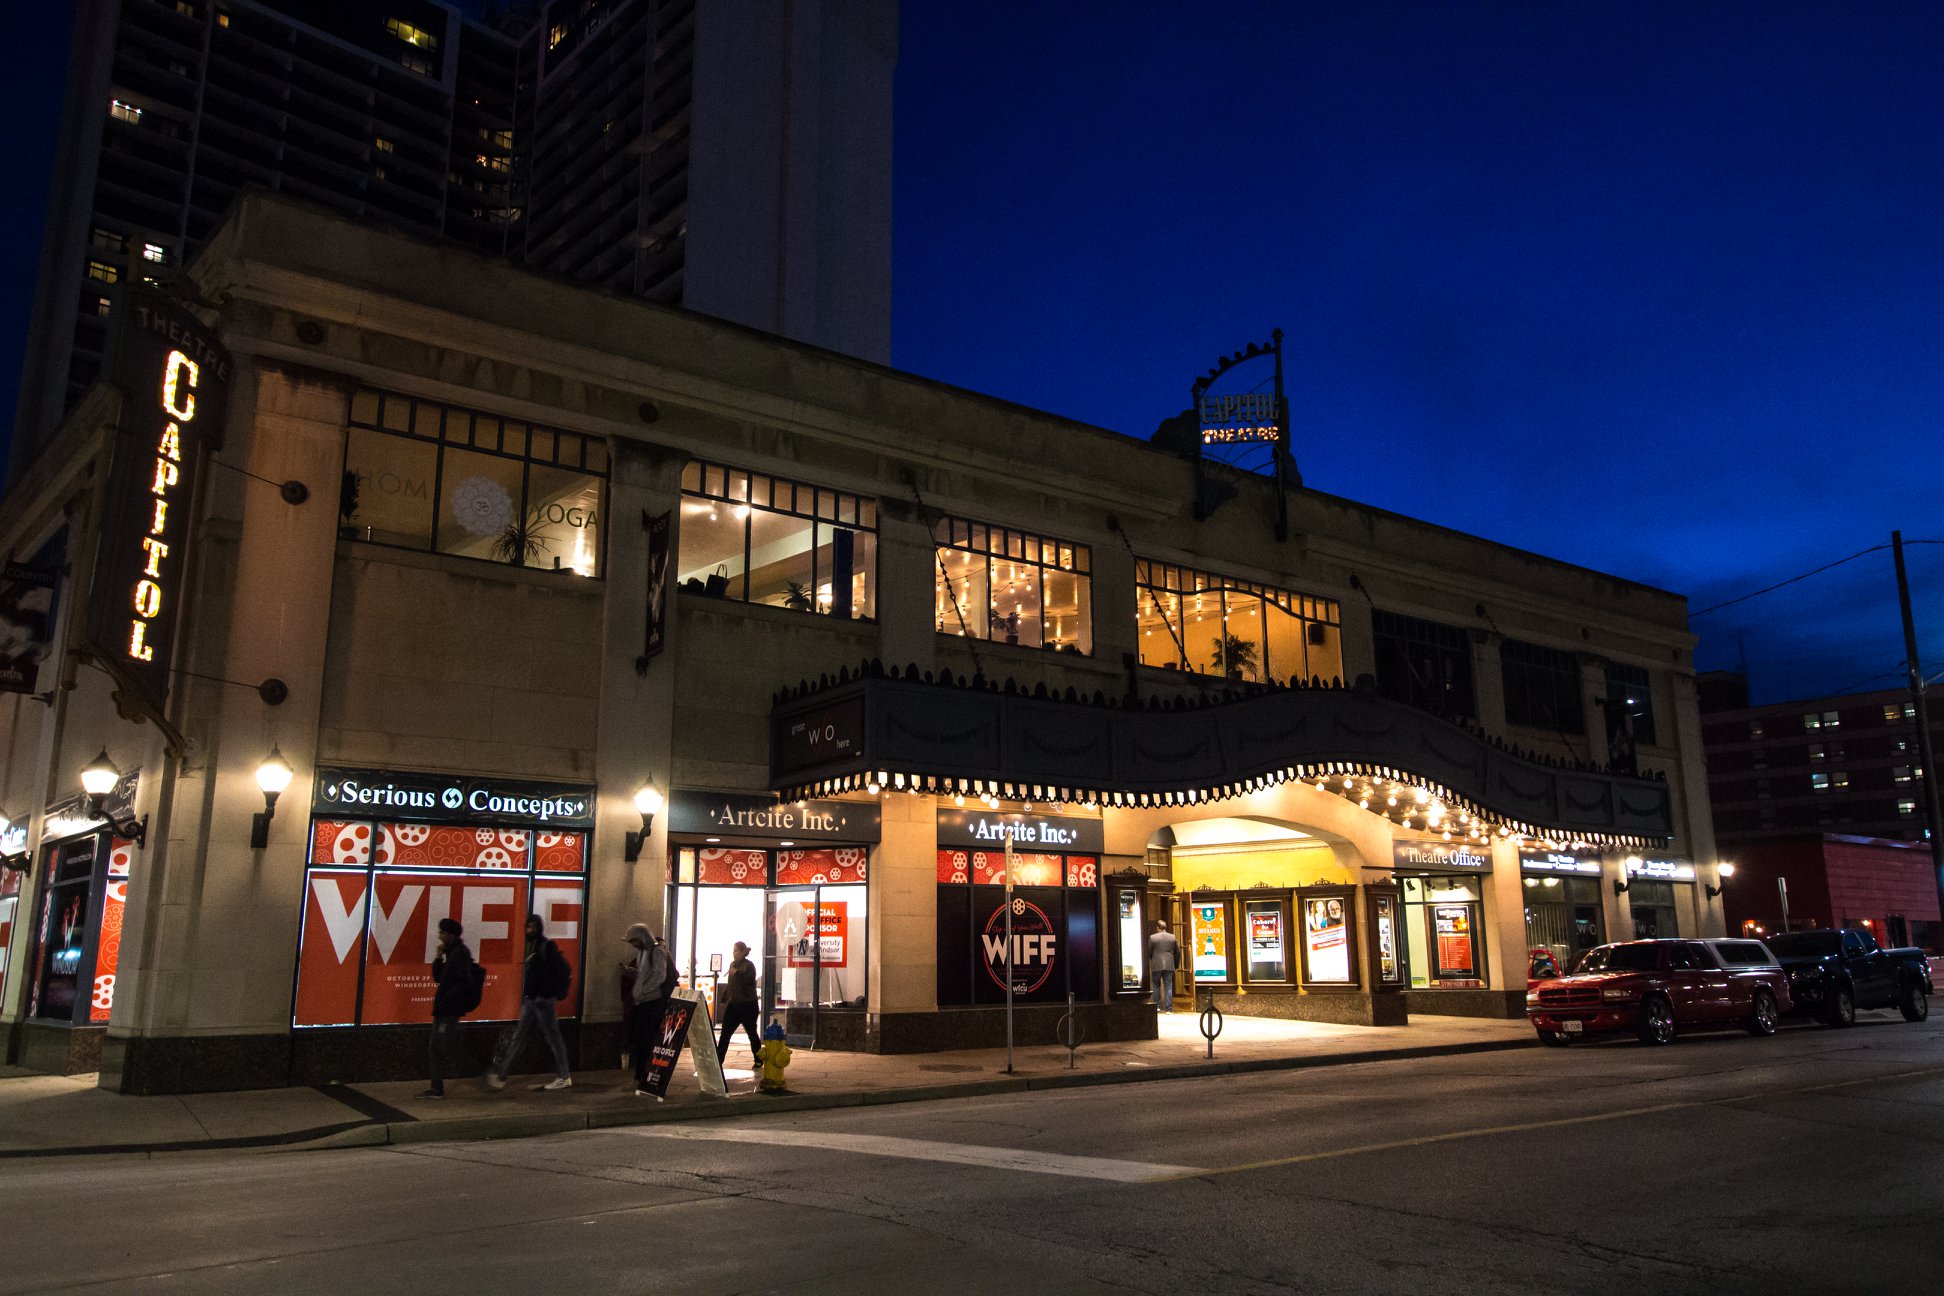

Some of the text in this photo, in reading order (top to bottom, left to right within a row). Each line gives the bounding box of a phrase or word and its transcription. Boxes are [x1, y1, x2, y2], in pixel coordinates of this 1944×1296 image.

[138, 307, 228, 382] THEATRE
[1201, 393, 1280, 423] CAPITOL
[1201, 426, 1280, 443] THEATRE
[129, 350, 199, 661] CAPITOL
[530, 502, 598, 529] YOGA
[341, 780, 574, 820] Serious Concepts
[717, 804, 840, 832] Artcite Inc.
[1039, 822, 1072, 844] Inc.
[1407, 847, 1482, 867] Theatre Office
[310, 878, 584, 966] WIFF
[981, 934, 1057, 966] WIFF
